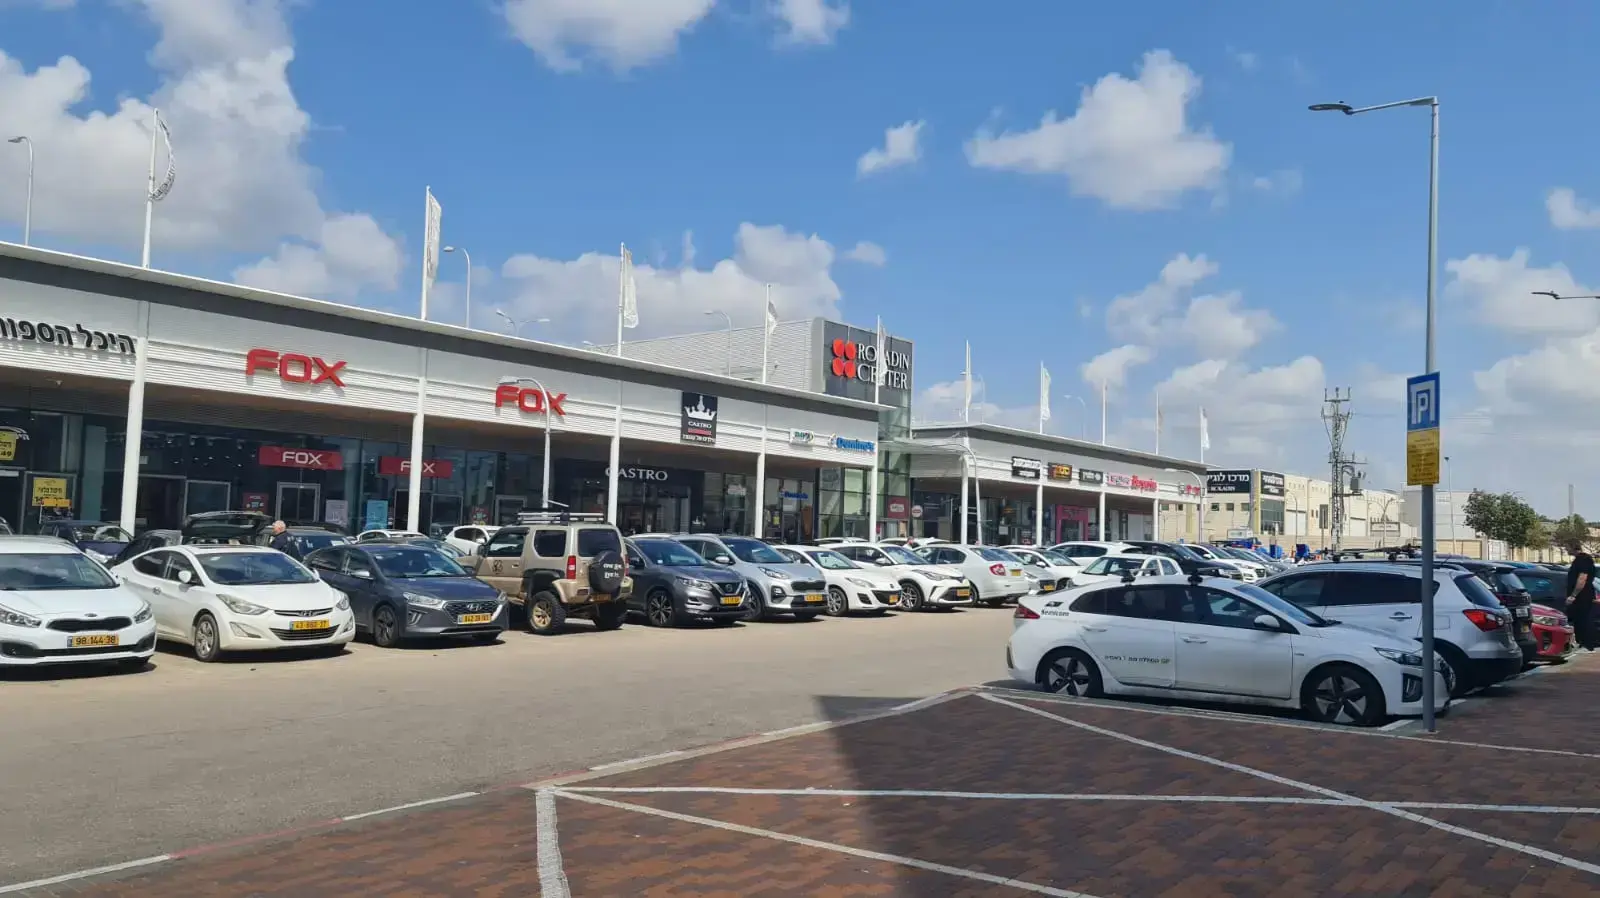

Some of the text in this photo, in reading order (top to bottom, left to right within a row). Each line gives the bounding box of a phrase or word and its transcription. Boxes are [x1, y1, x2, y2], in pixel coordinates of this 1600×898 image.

[76, 323, 136, 354] היכל
[246, 348, 346, 388] FOX
[857, 343, 910, 370] ROADIN
[857, 363, 908, 390] CETER
[495, 385, 567, 416] FOX
[282, 451, 323, 466] FOX
[401, 460, 436, 474] FX
